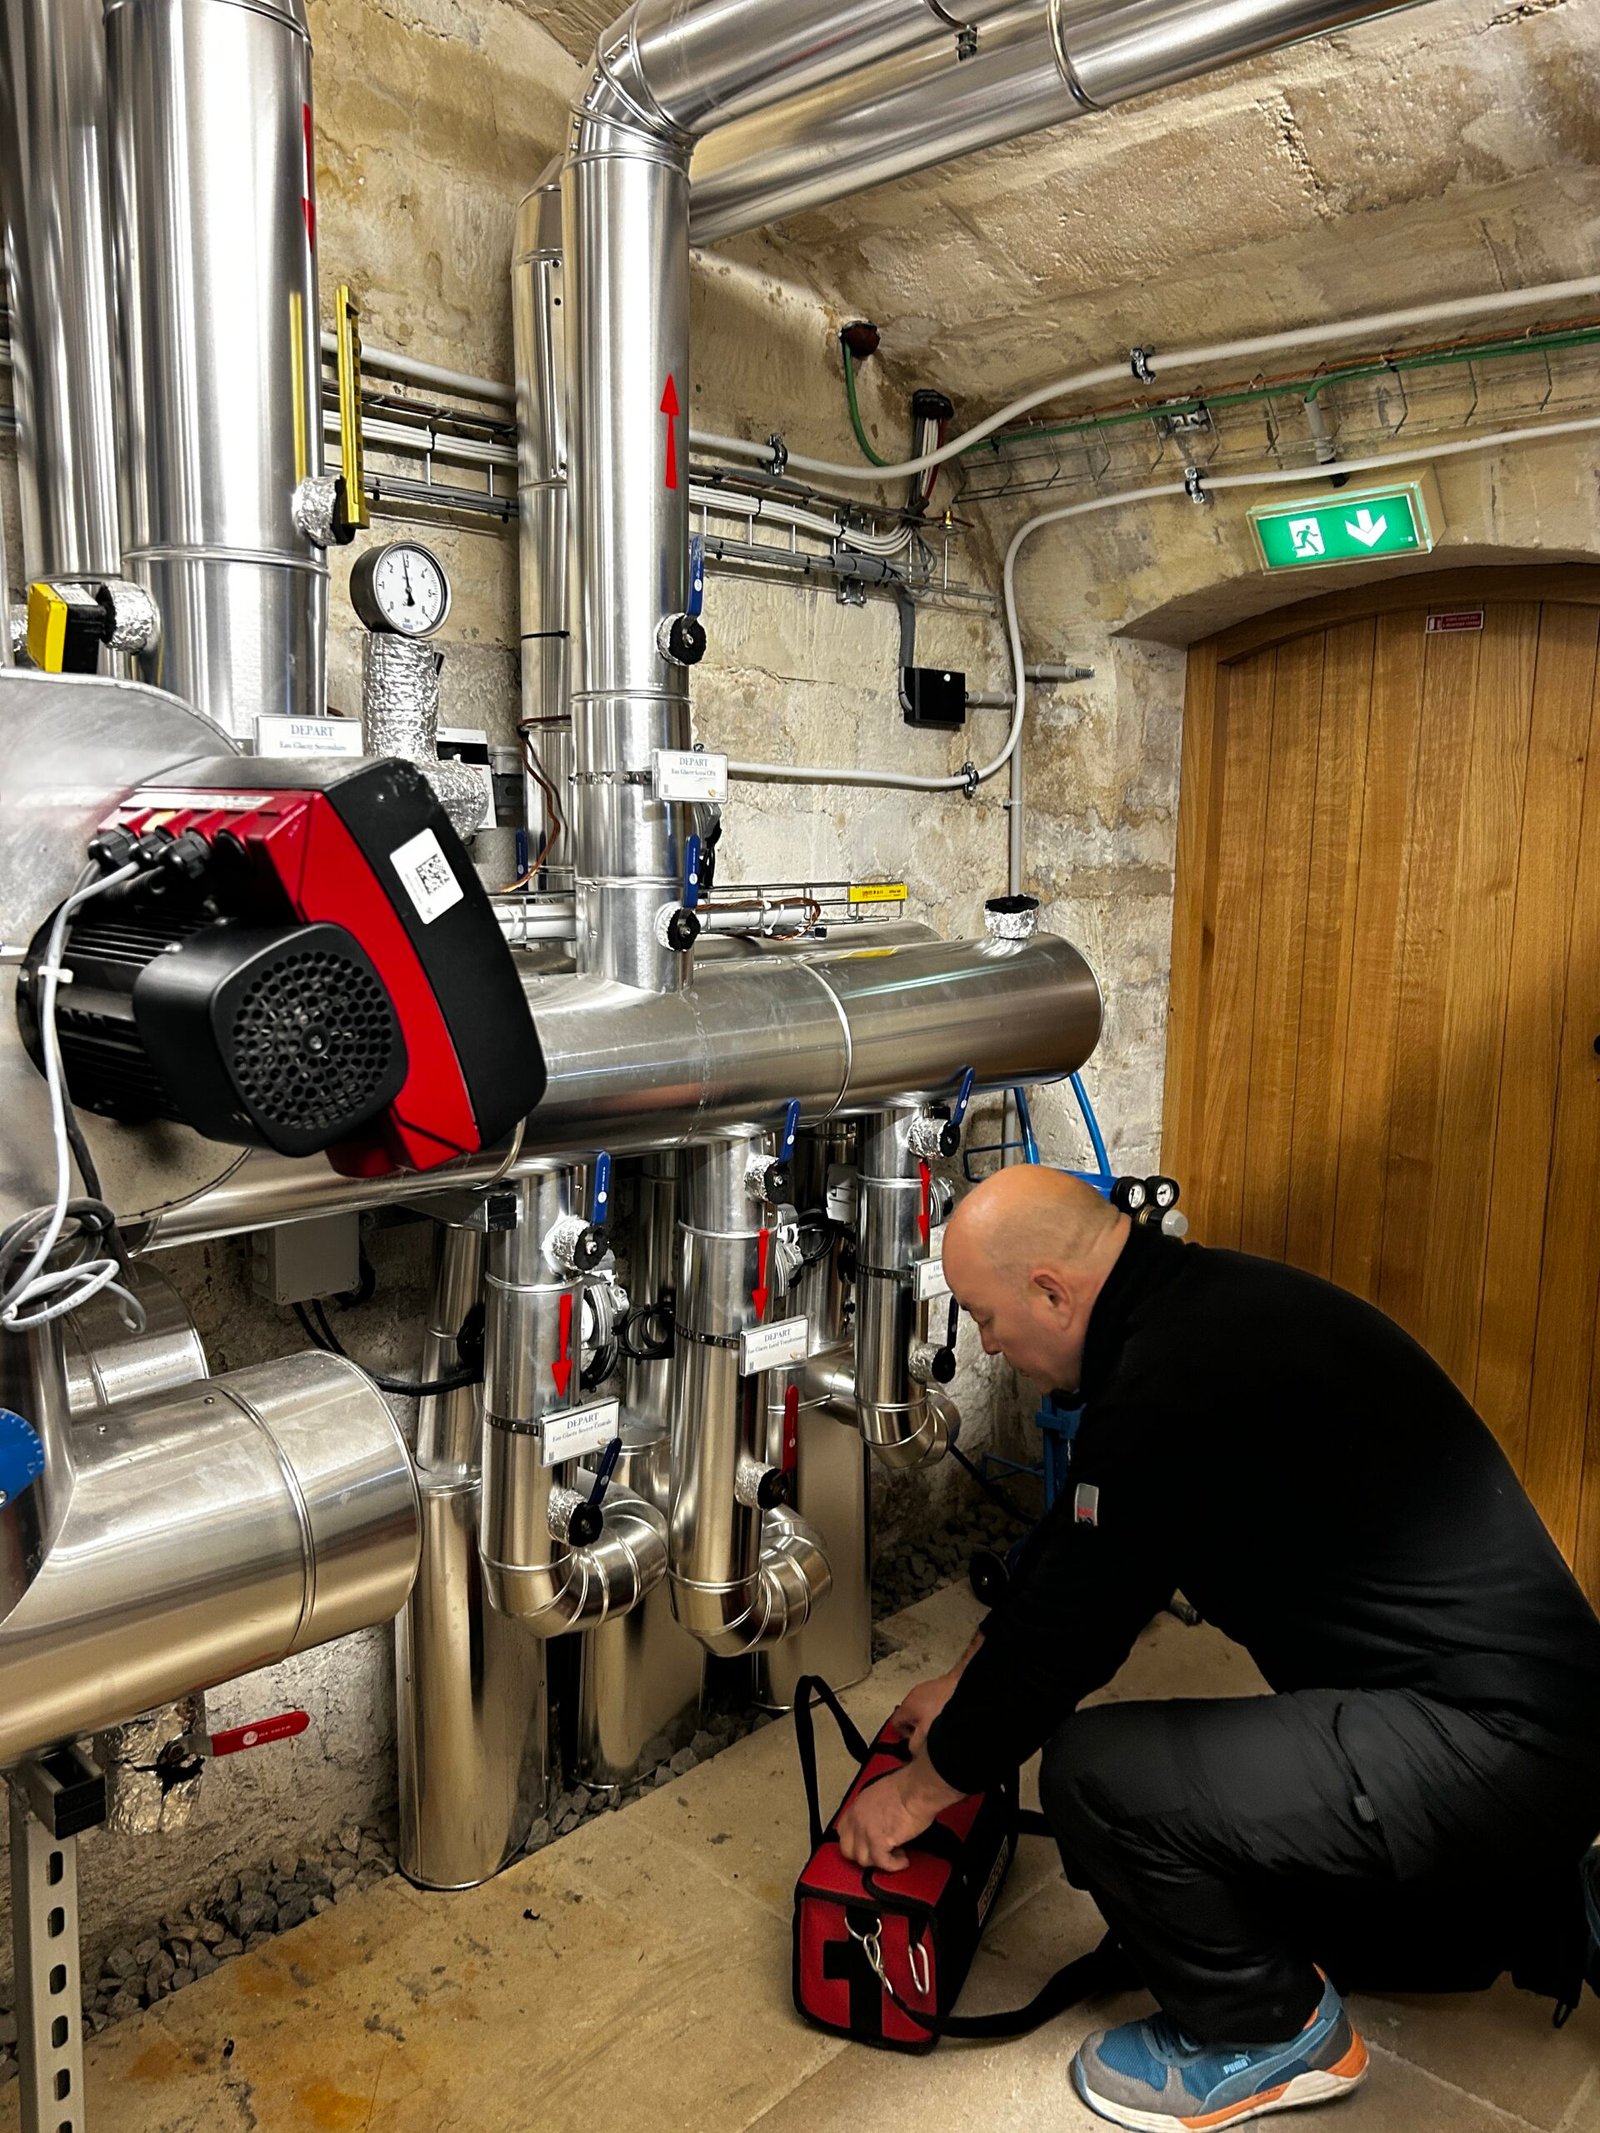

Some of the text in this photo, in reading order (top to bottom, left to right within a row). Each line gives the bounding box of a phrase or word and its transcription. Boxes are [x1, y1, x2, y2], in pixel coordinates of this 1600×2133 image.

[290, 724, 335, 737] DEPART
[679, 757, 709, 767] DEPART
[764, 1328, 792, 1342] DEPART
[567, 1413, 600, 1429] DEPART
[1223, 2058, 1249, 2075] PUMA
